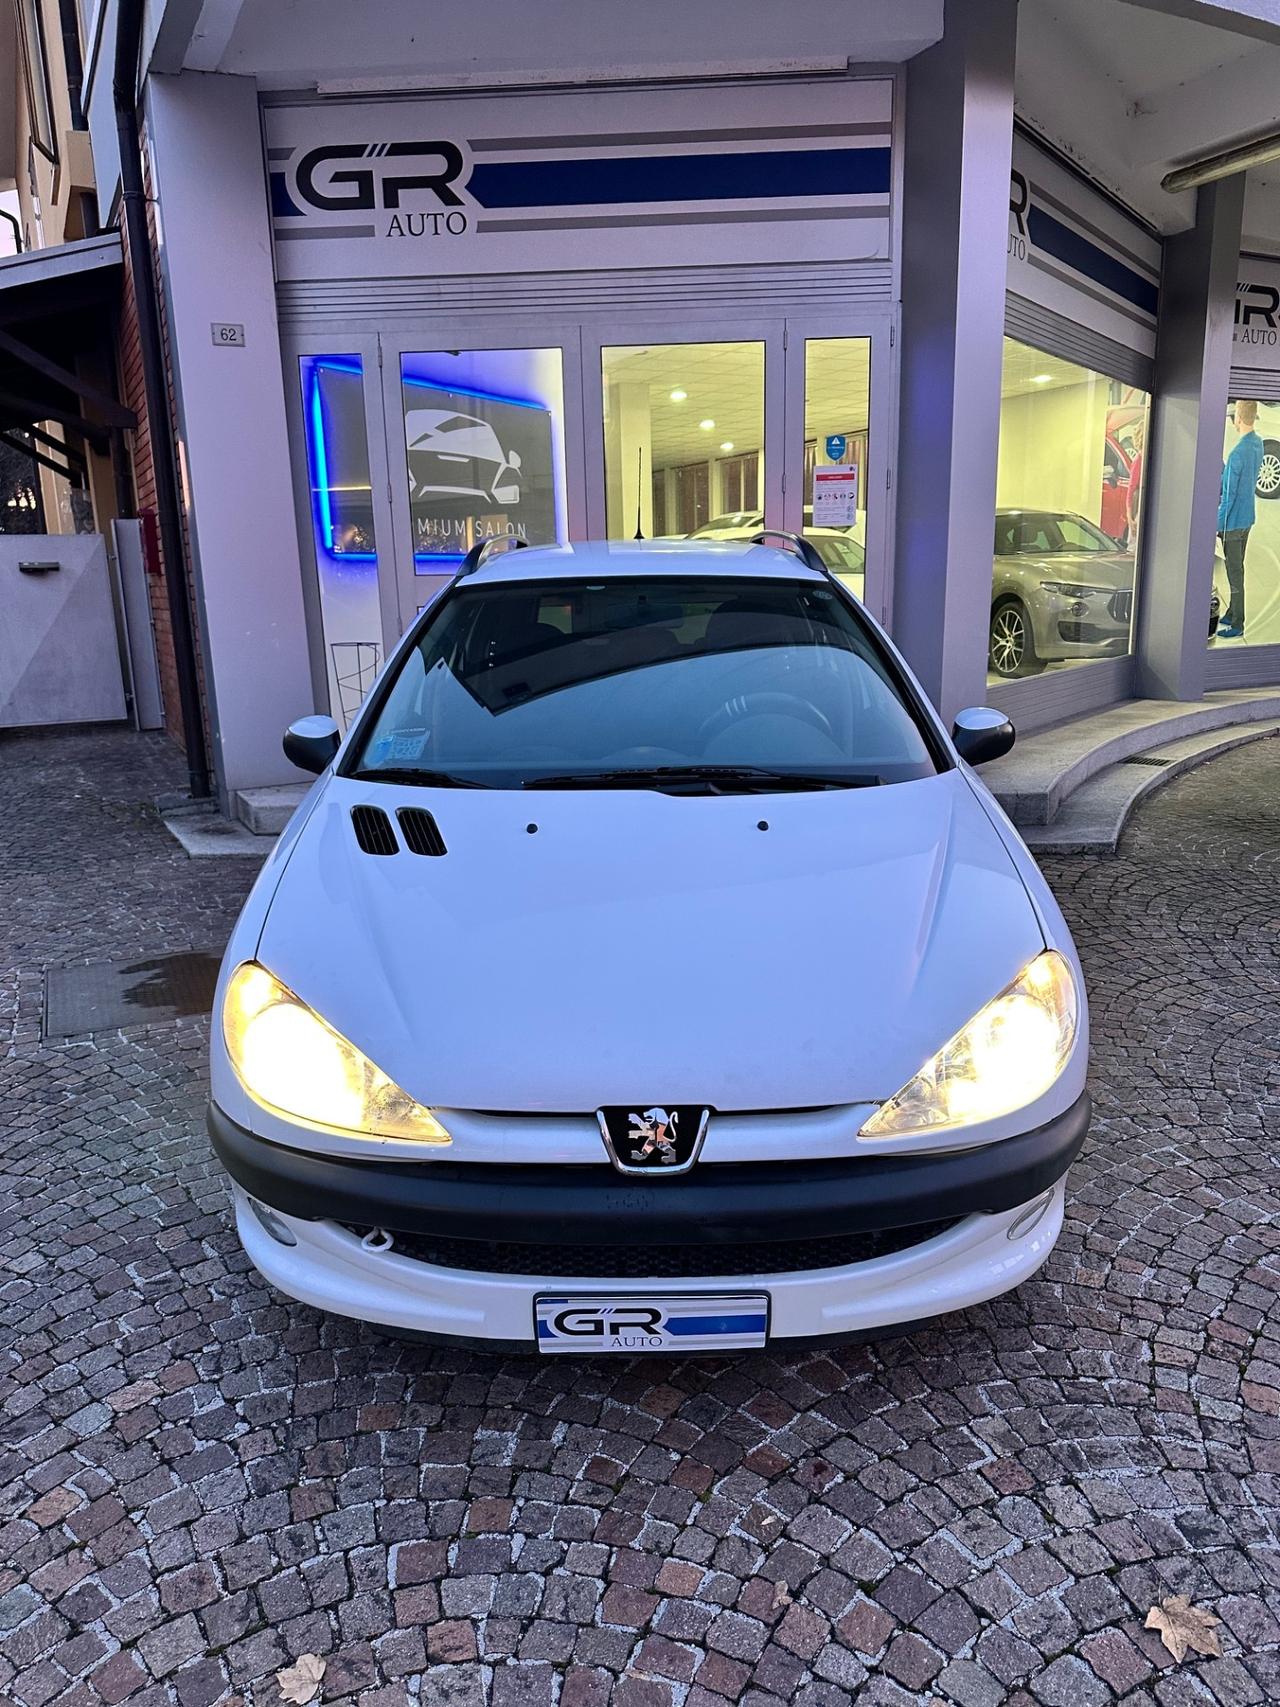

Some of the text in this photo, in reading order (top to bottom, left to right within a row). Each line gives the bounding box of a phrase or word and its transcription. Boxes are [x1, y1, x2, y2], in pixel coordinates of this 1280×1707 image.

[296, 141, 466, 211] GR
[1010, 168, 1027, 236] R
[386, 211, 467, 237] AUTO
[1007, 233, 1025, 261] UTO
[220, 327, 237, 342] 62
[1240, 328, 1277, 346] AUTO
[475, 520, 526, 539] SALON
[554, 1308, 662, 1336] GR
[611, 1336, 663, 1347] AUTO
